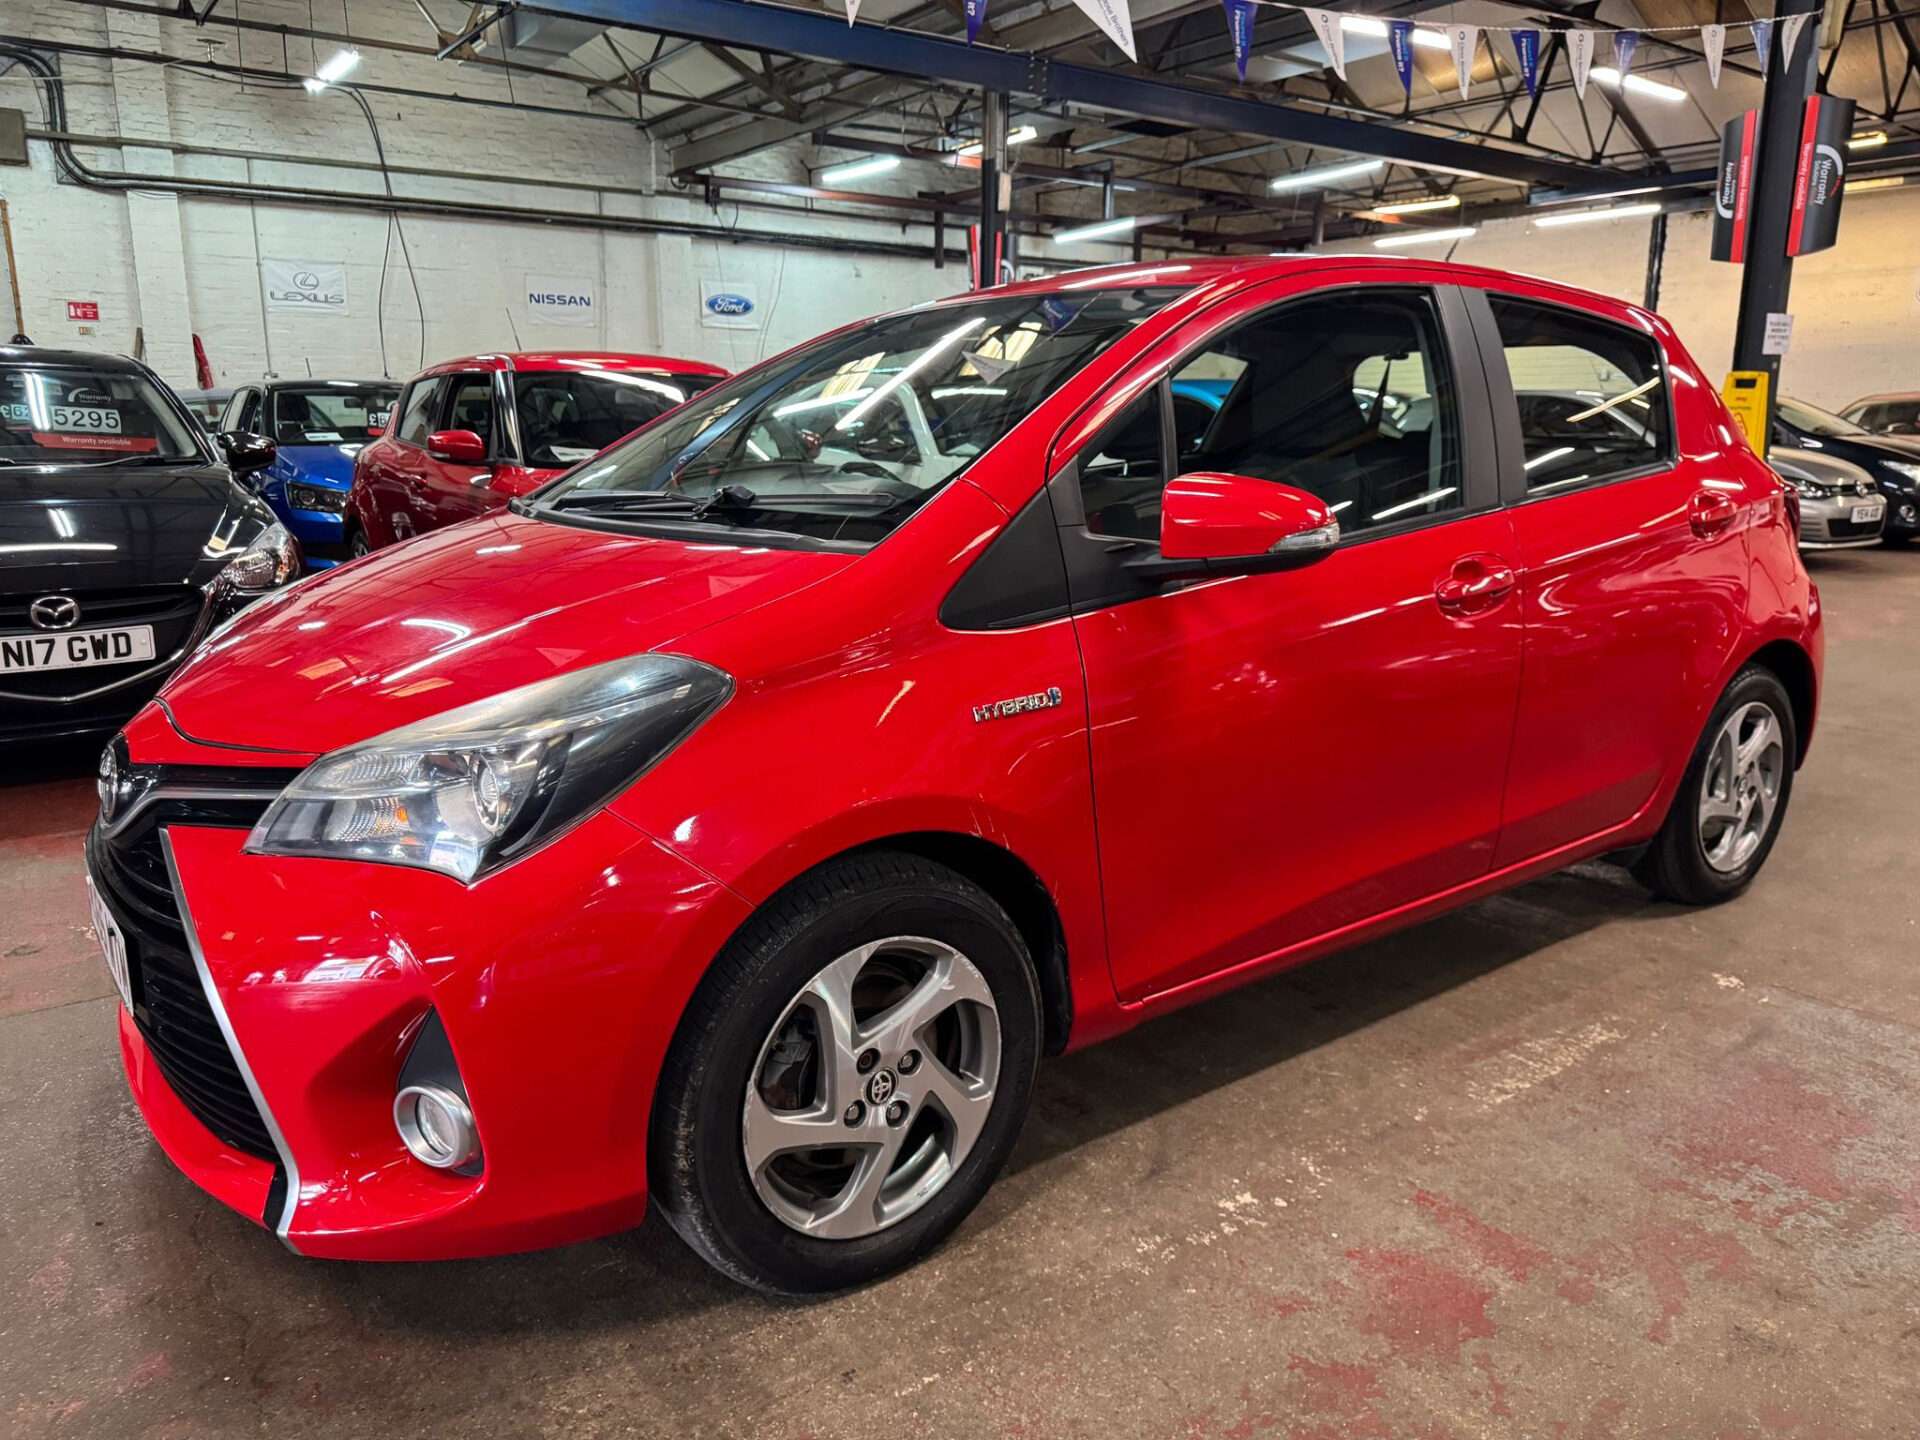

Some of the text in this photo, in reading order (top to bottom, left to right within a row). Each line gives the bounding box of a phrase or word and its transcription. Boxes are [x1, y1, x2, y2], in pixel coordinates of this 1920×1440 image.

[1722, 162, 1734, 205] Warranty
[1815, 159, 1833, 206] Warranty
[269, 291, 344, 304] LEXUS
[529, 293, 592, 307] NISSAN
[714, 295, 746, 314] Ford
[54, 408, 120, 429] 5295
[62, 436, 97, 446] Warranty
[67, 632, 132, 662] GWD
[972, 692, 1049, 722] HYBRID
